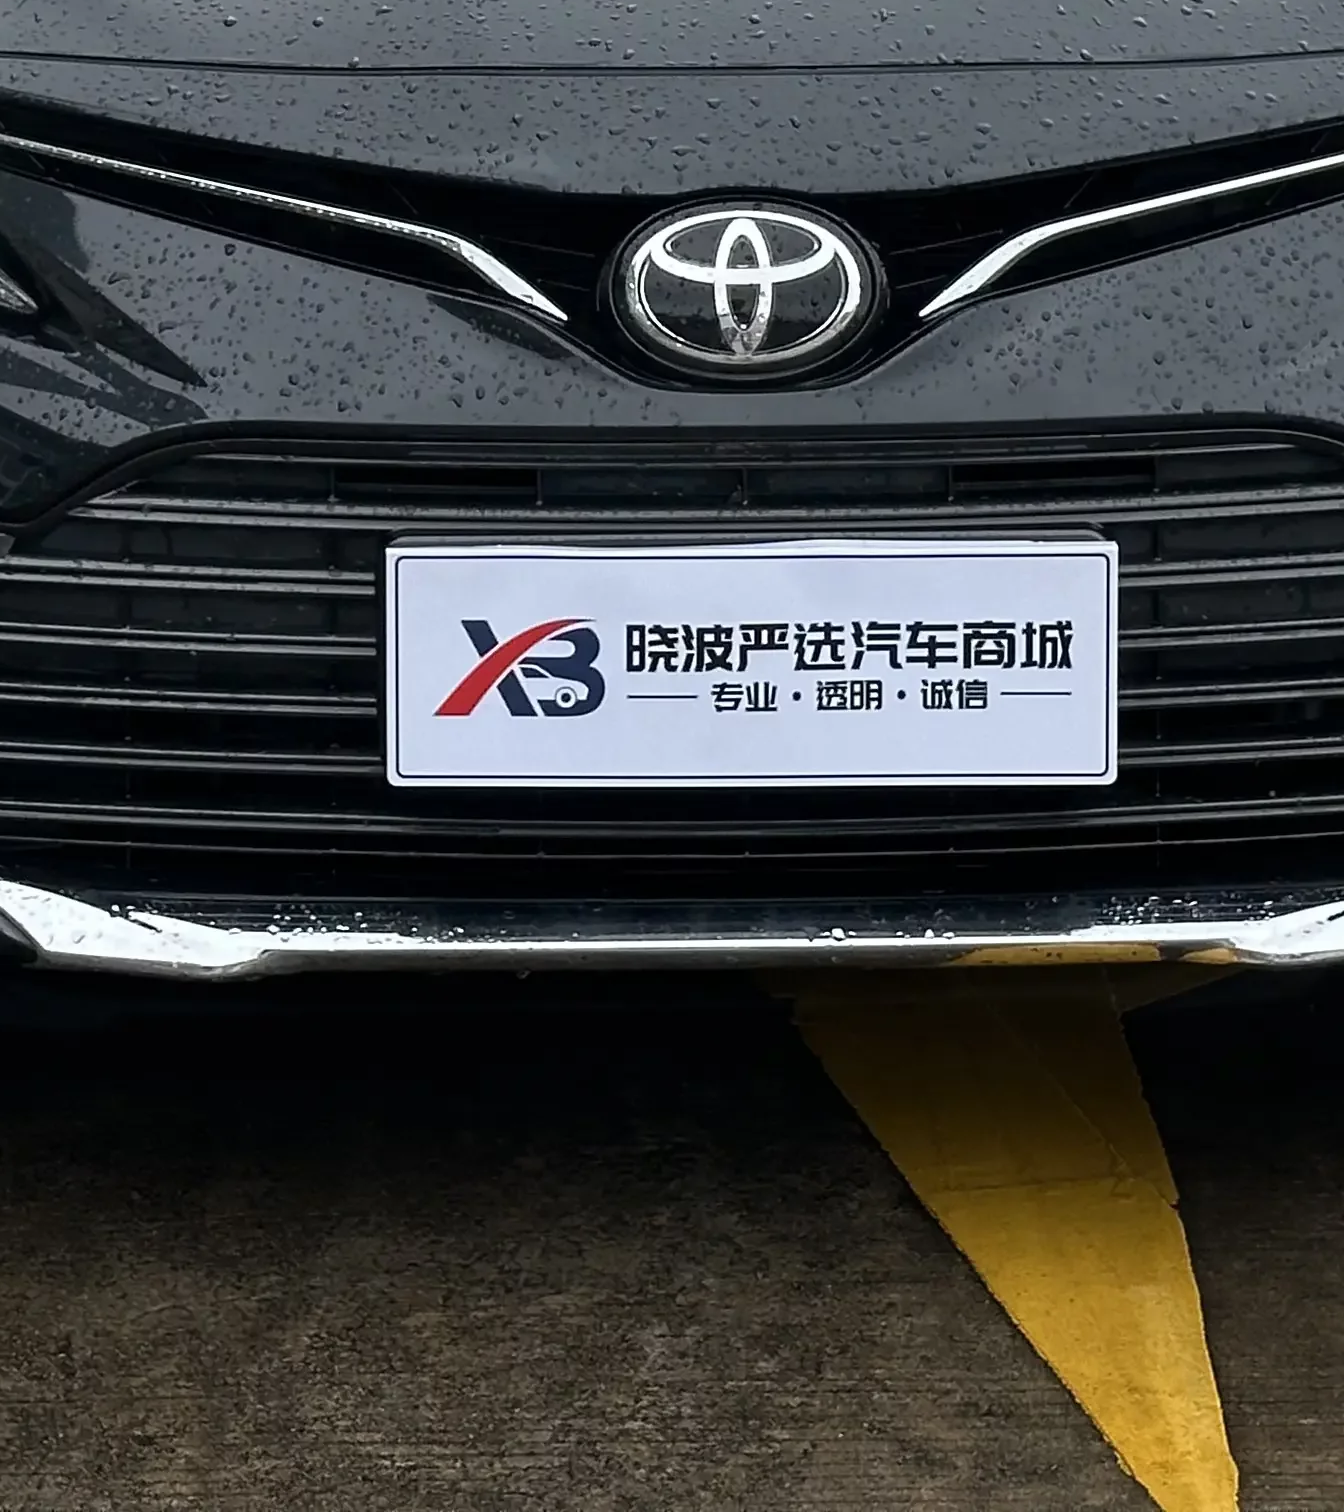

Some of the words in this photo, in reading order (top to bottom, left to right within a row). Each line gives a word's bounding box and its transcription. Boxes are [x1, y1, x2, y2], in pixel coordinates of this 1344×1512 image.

[626, 620, 1073, 672] 晓波严选汽车商城
